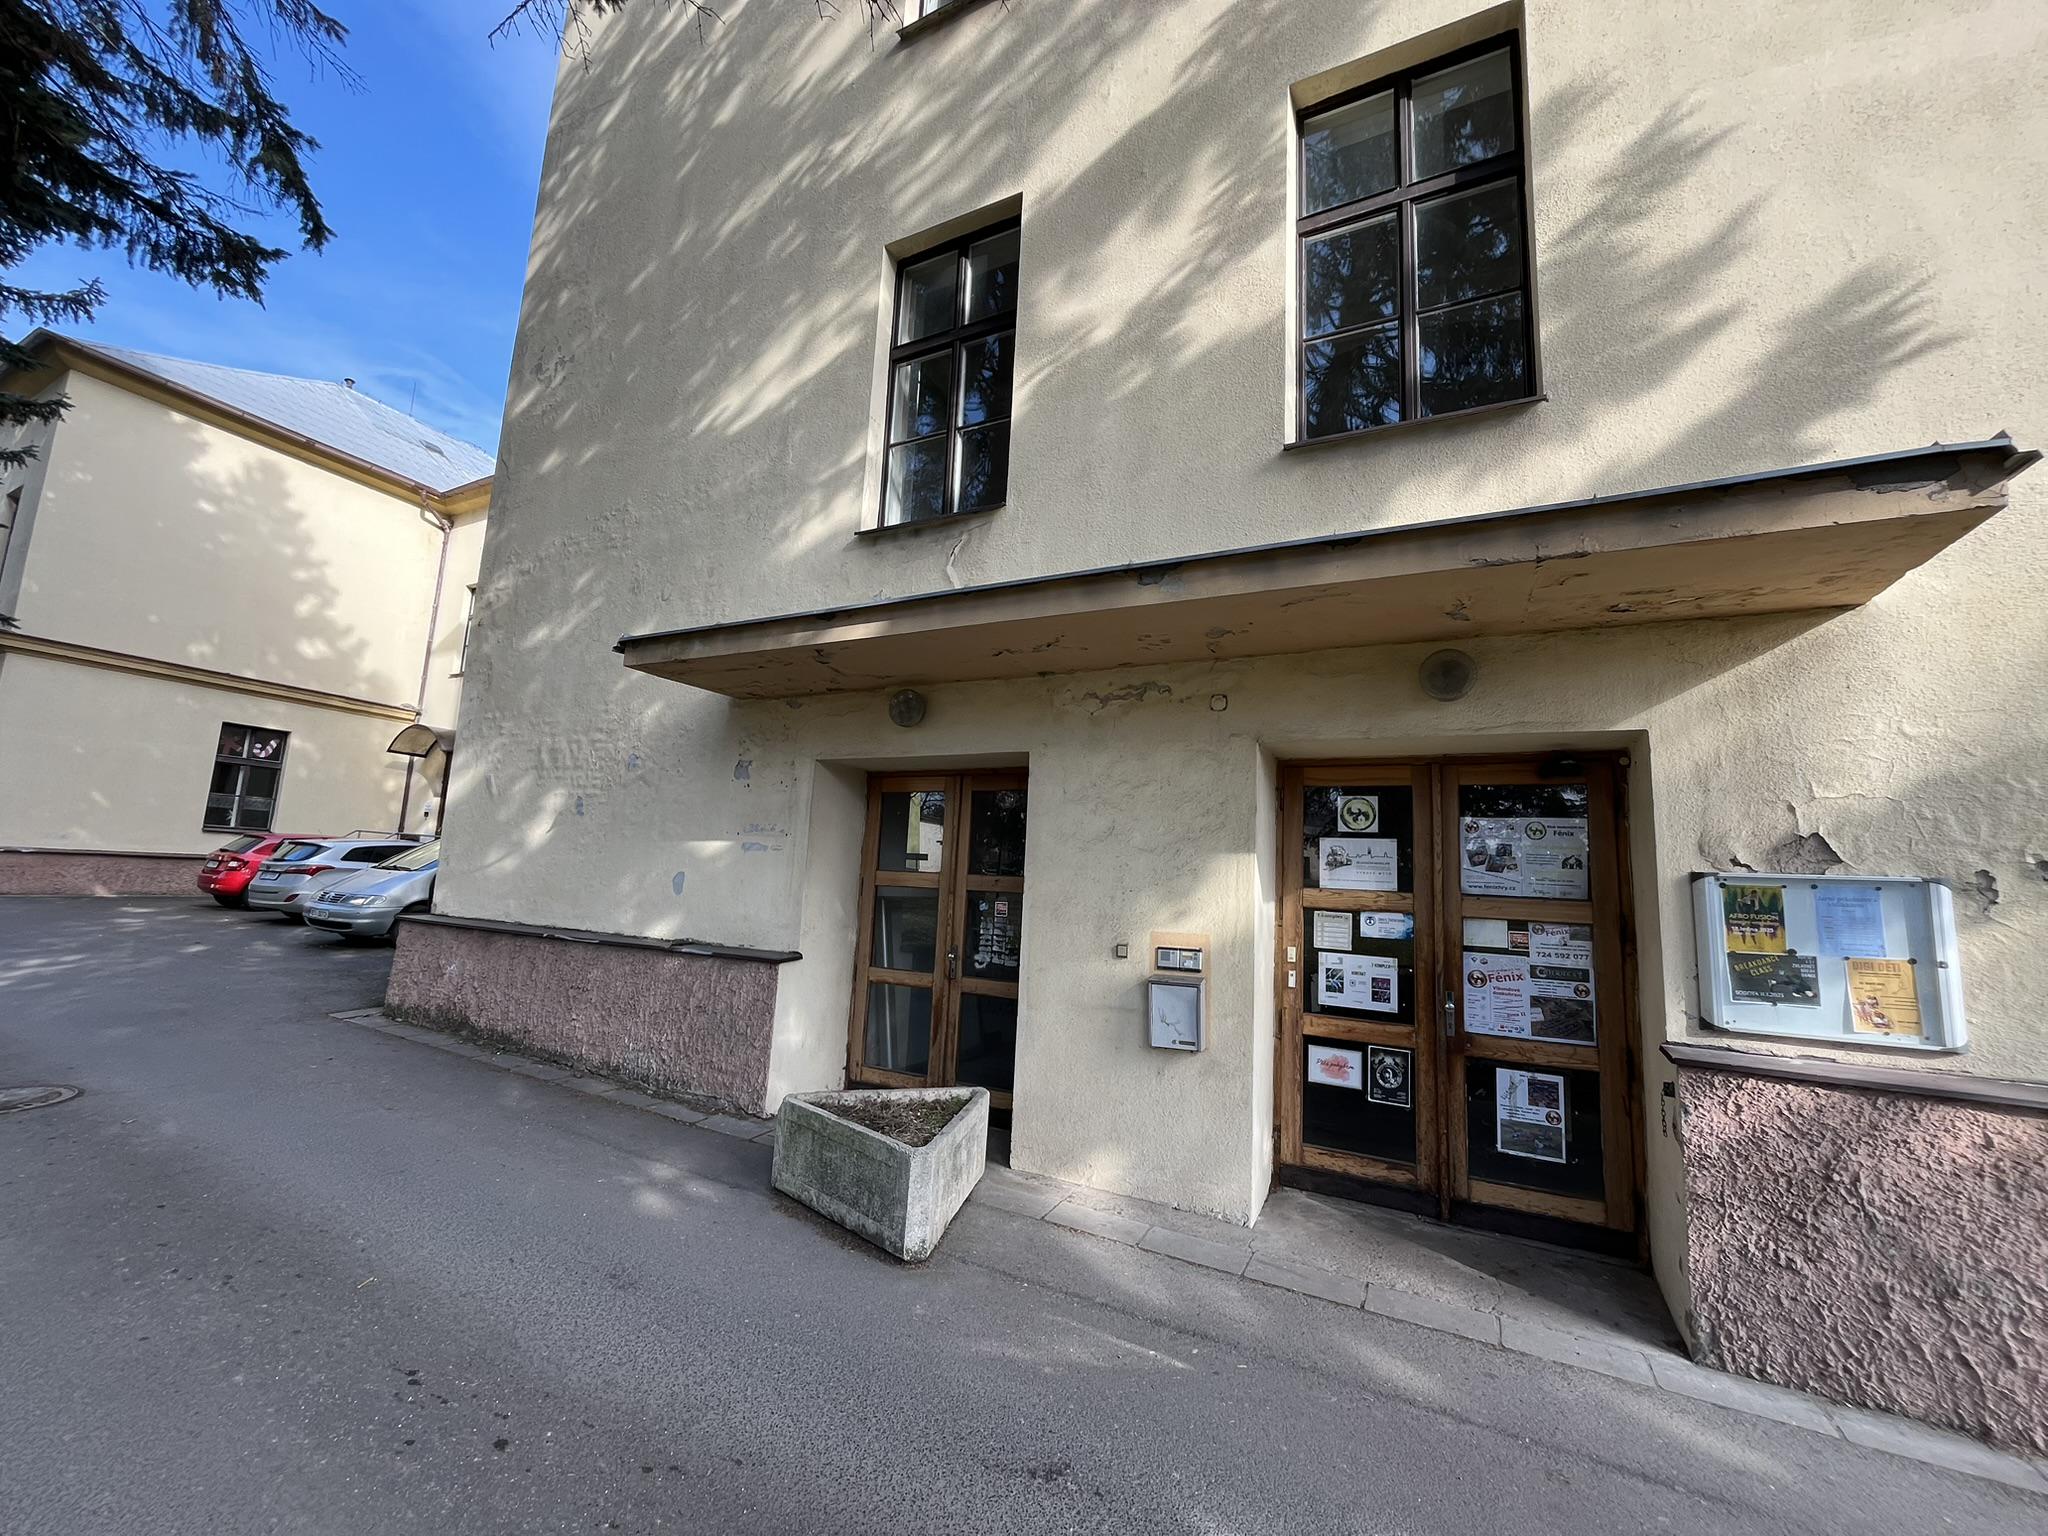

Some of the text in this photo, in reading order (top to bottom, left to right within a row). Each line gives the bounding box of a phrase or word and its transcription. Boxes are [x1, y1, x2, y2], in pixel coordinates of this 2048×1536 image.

[1733, 955, 1780, 972] BREAKDANCE
[1488, 971, 1524, 983] Fénix
[1750, 965, 1774, 977] CLASS
